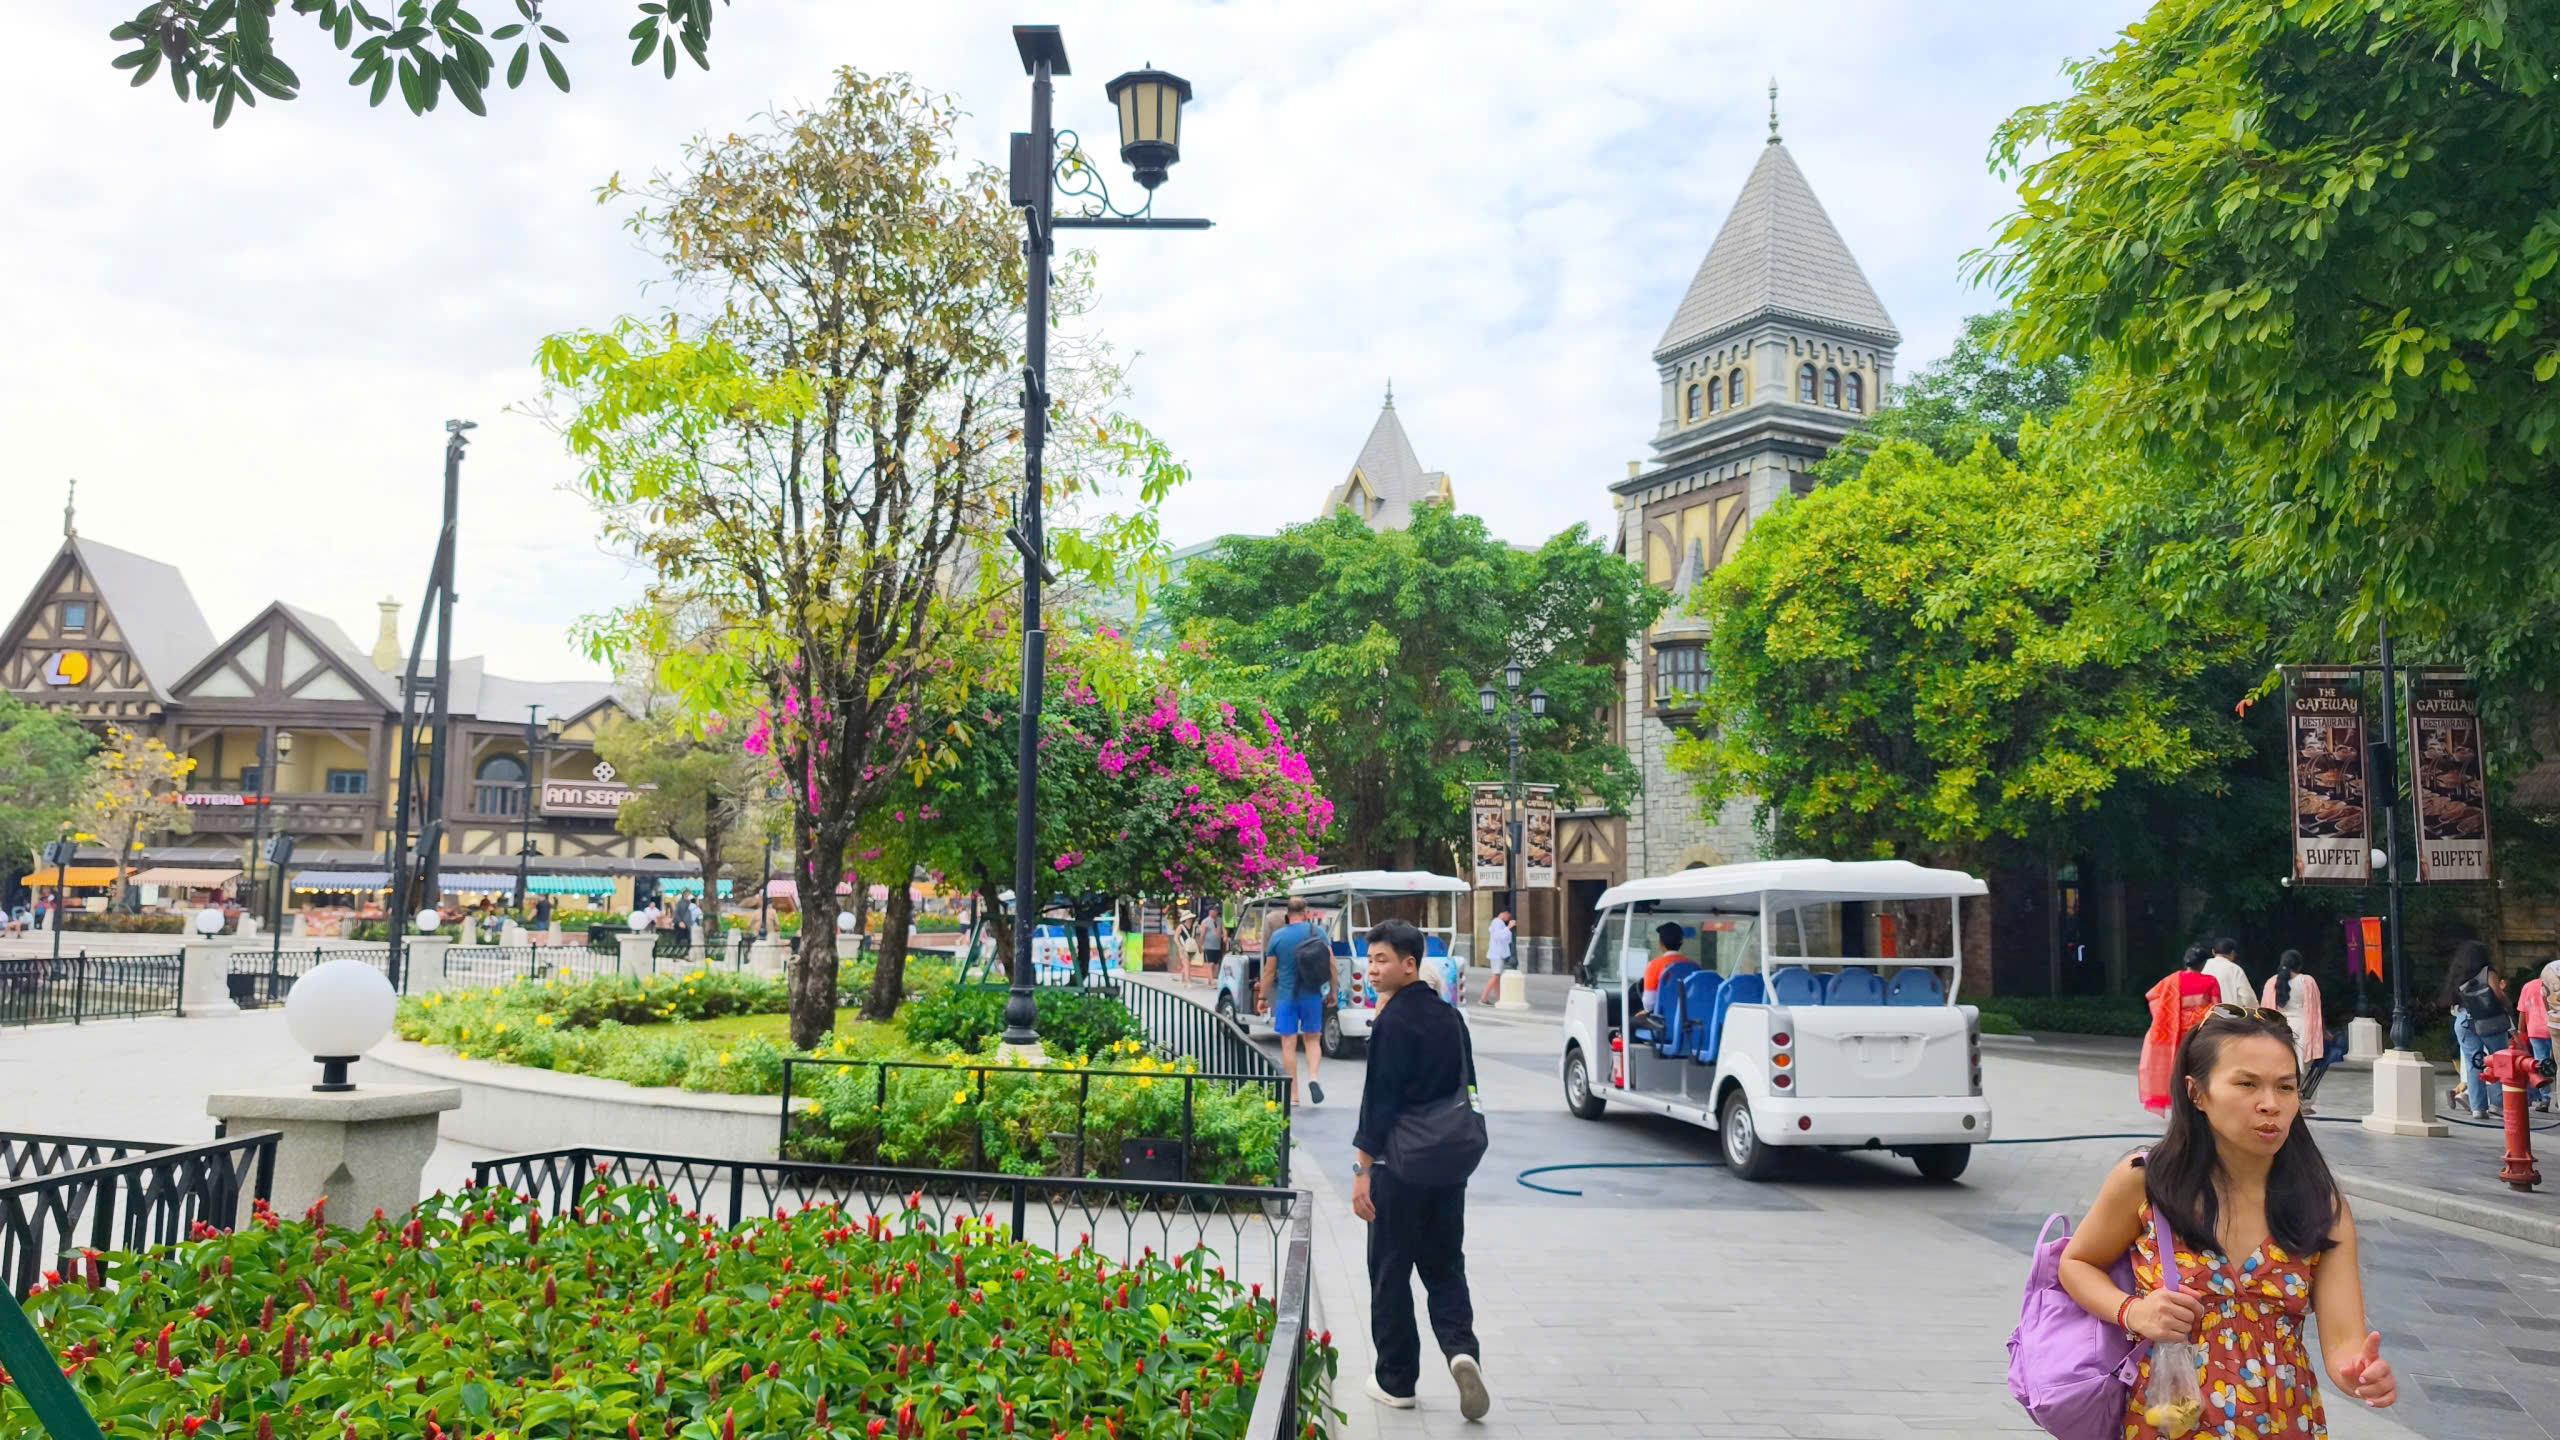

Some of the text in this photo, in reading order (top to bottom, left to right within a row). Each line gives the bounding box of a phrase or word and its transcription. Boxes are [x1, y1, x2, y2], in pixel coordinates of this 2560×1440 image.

[2318, 687, 2336, 697] THE
[2438, 689, 2455, 698] THE
[2295, 698, 2358, 714] GATEWAY
[2302, 716, 2354, 728] RESTAURANT
[2423, 719, 2471, 729] RESTAURANT
[177, 793, 244, 806] LOTTERIA
[2306, 849, 2361, 865] BUFFET
[2432, 850, 2483, 867] BUFFET
